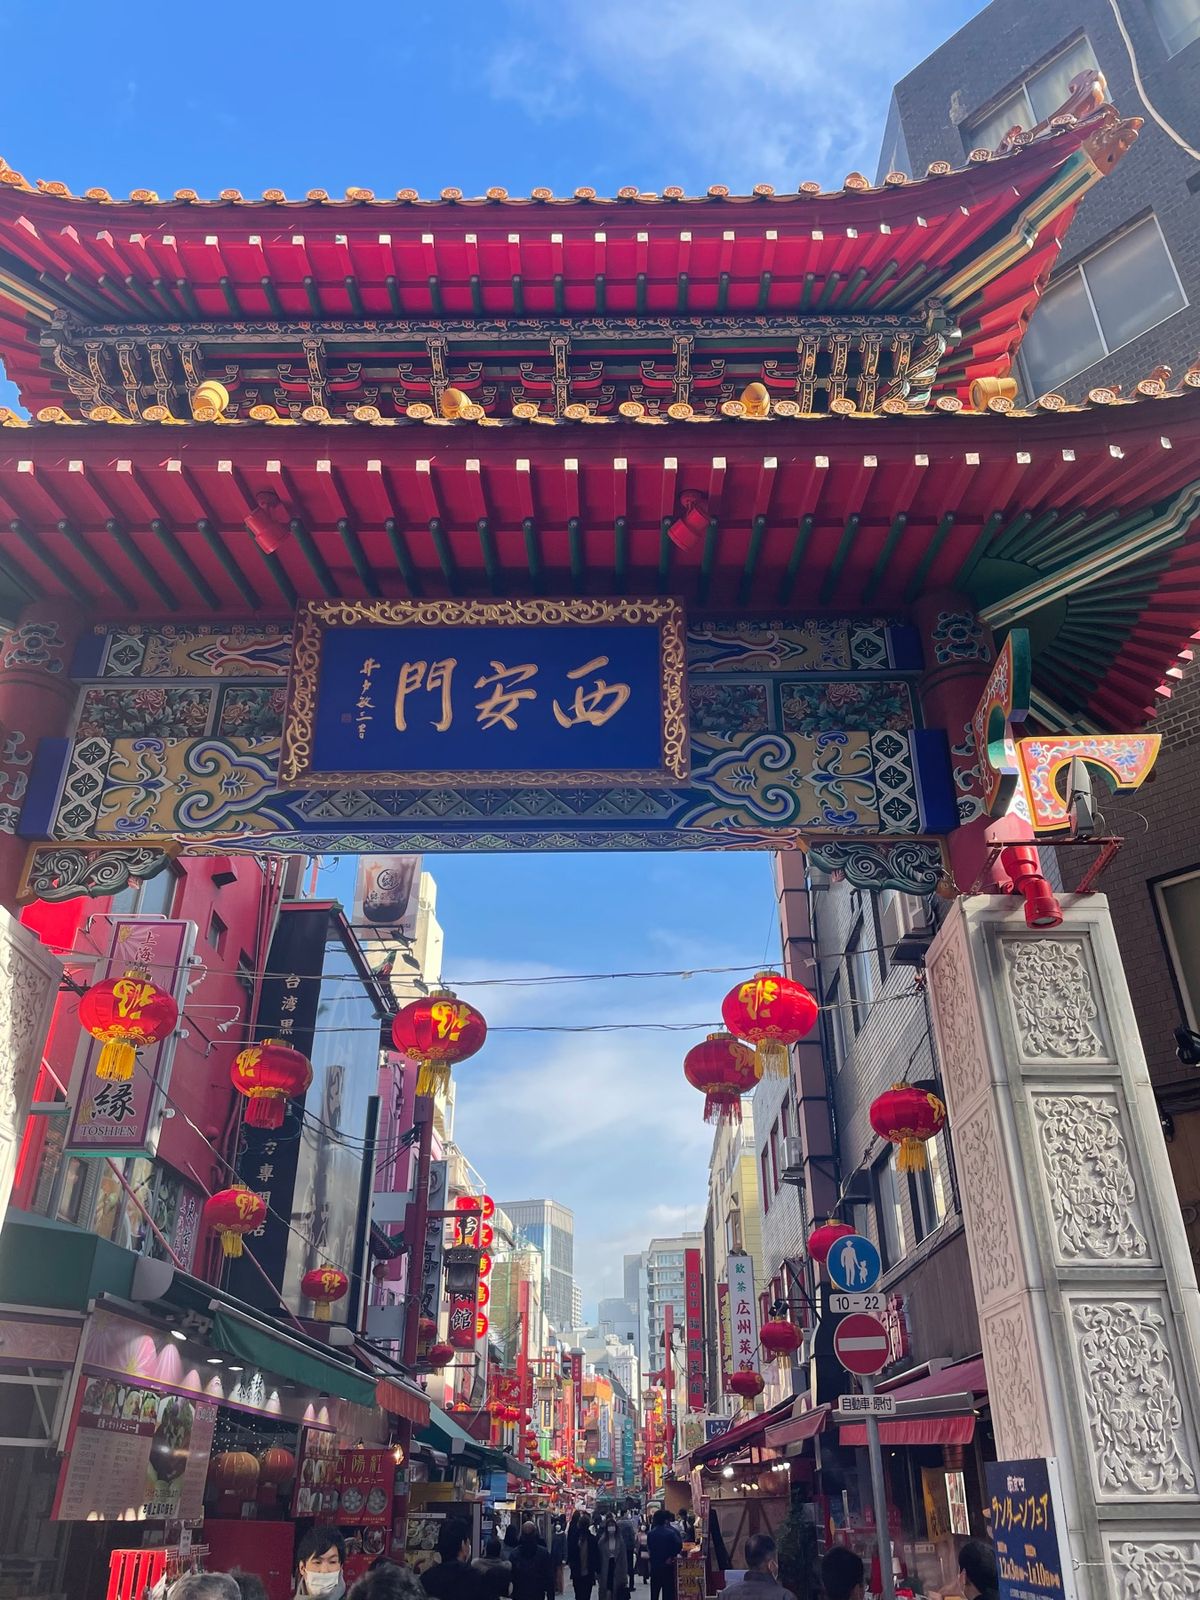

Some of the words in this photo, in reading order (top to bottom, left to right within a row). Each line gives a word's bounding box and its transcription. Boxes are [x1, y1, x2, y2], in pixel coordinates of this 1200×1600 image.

[395, 655, 631, 732] 西安門
[81, 1125, 137, 1136] TOSHIEN
